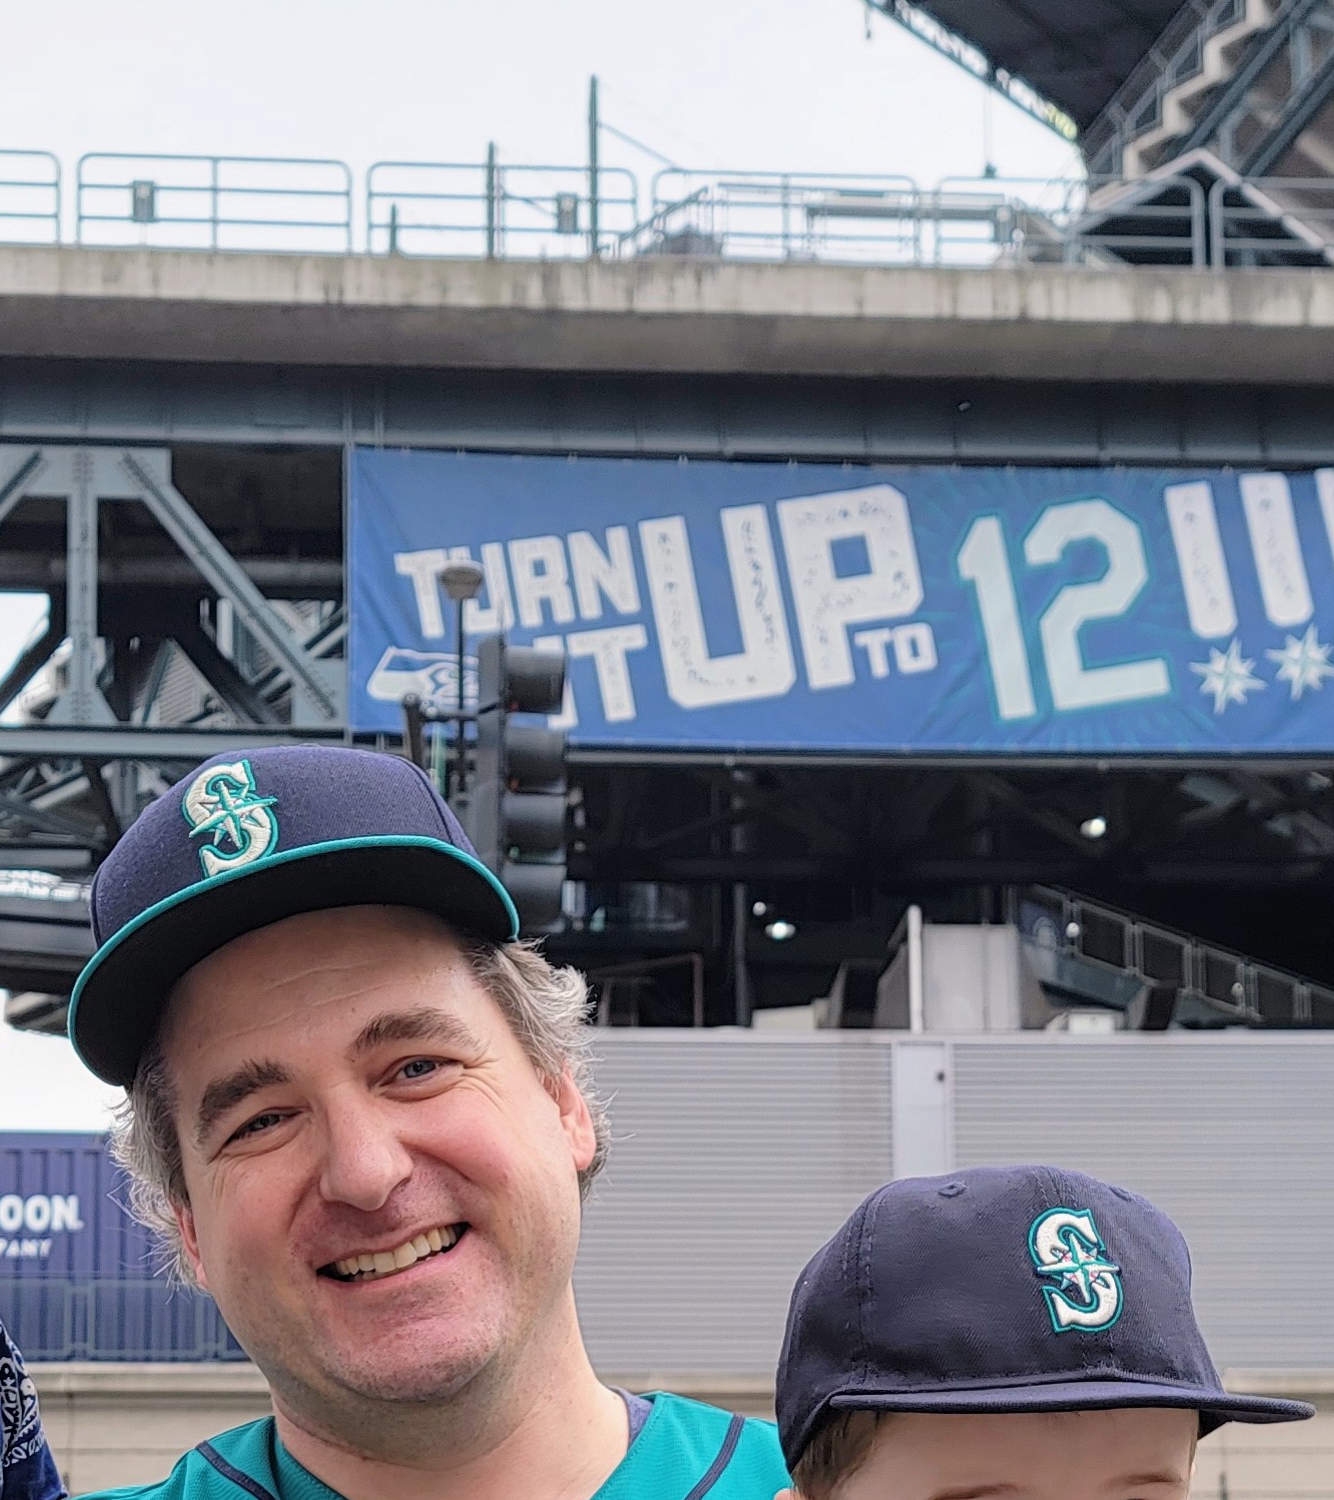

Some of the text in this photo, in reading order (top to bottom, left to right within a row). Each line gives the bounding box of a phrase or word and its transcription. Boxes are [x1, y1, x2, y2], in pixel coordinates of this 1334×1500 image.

[394, 525, 642, 640] TURN
[638, 483, 923, 709] UP
[854, 621, 939, 680] TO
